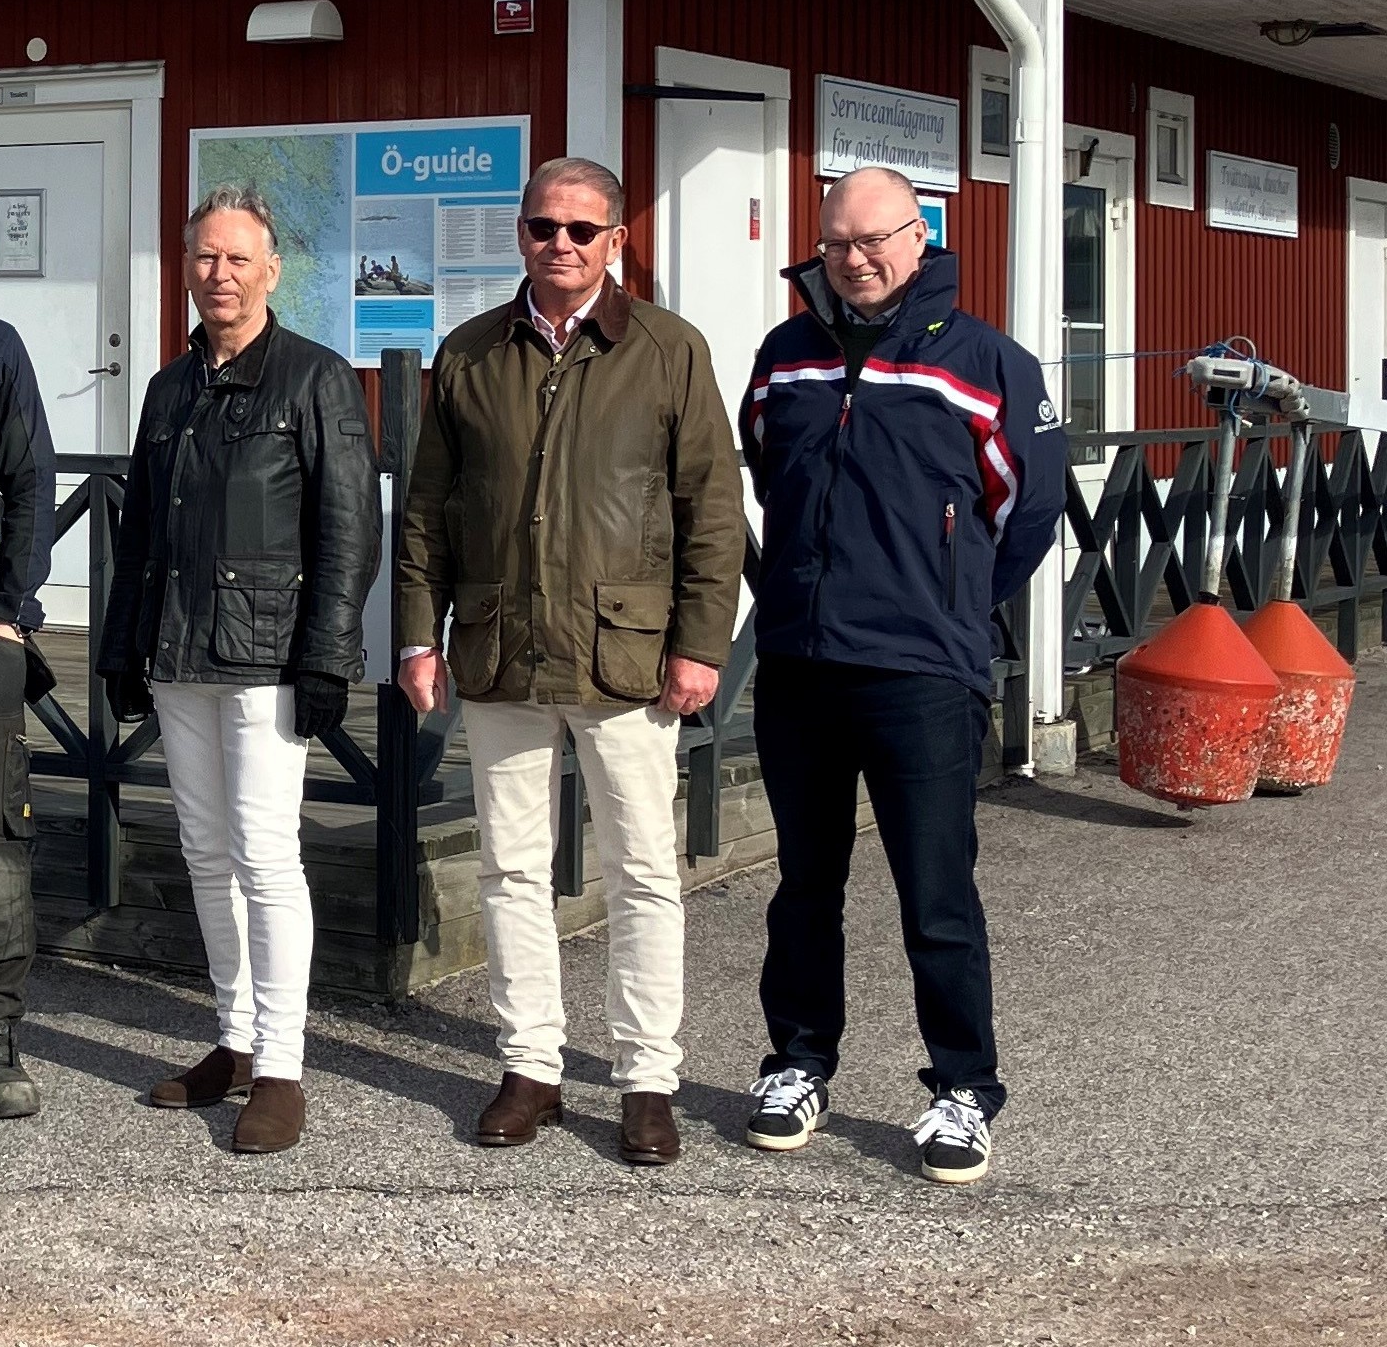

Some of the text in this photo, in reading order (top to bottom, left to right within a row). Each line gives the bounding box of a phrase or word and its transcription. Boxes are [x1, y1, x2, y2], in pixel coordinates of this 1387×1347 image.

[831, 90, 945, 143] Serviceanläggning
[381, 144, 493, 181] Ö-guide
[829, 127, 853, 167] för
[854, 134, 930, 170] gästhamnen
